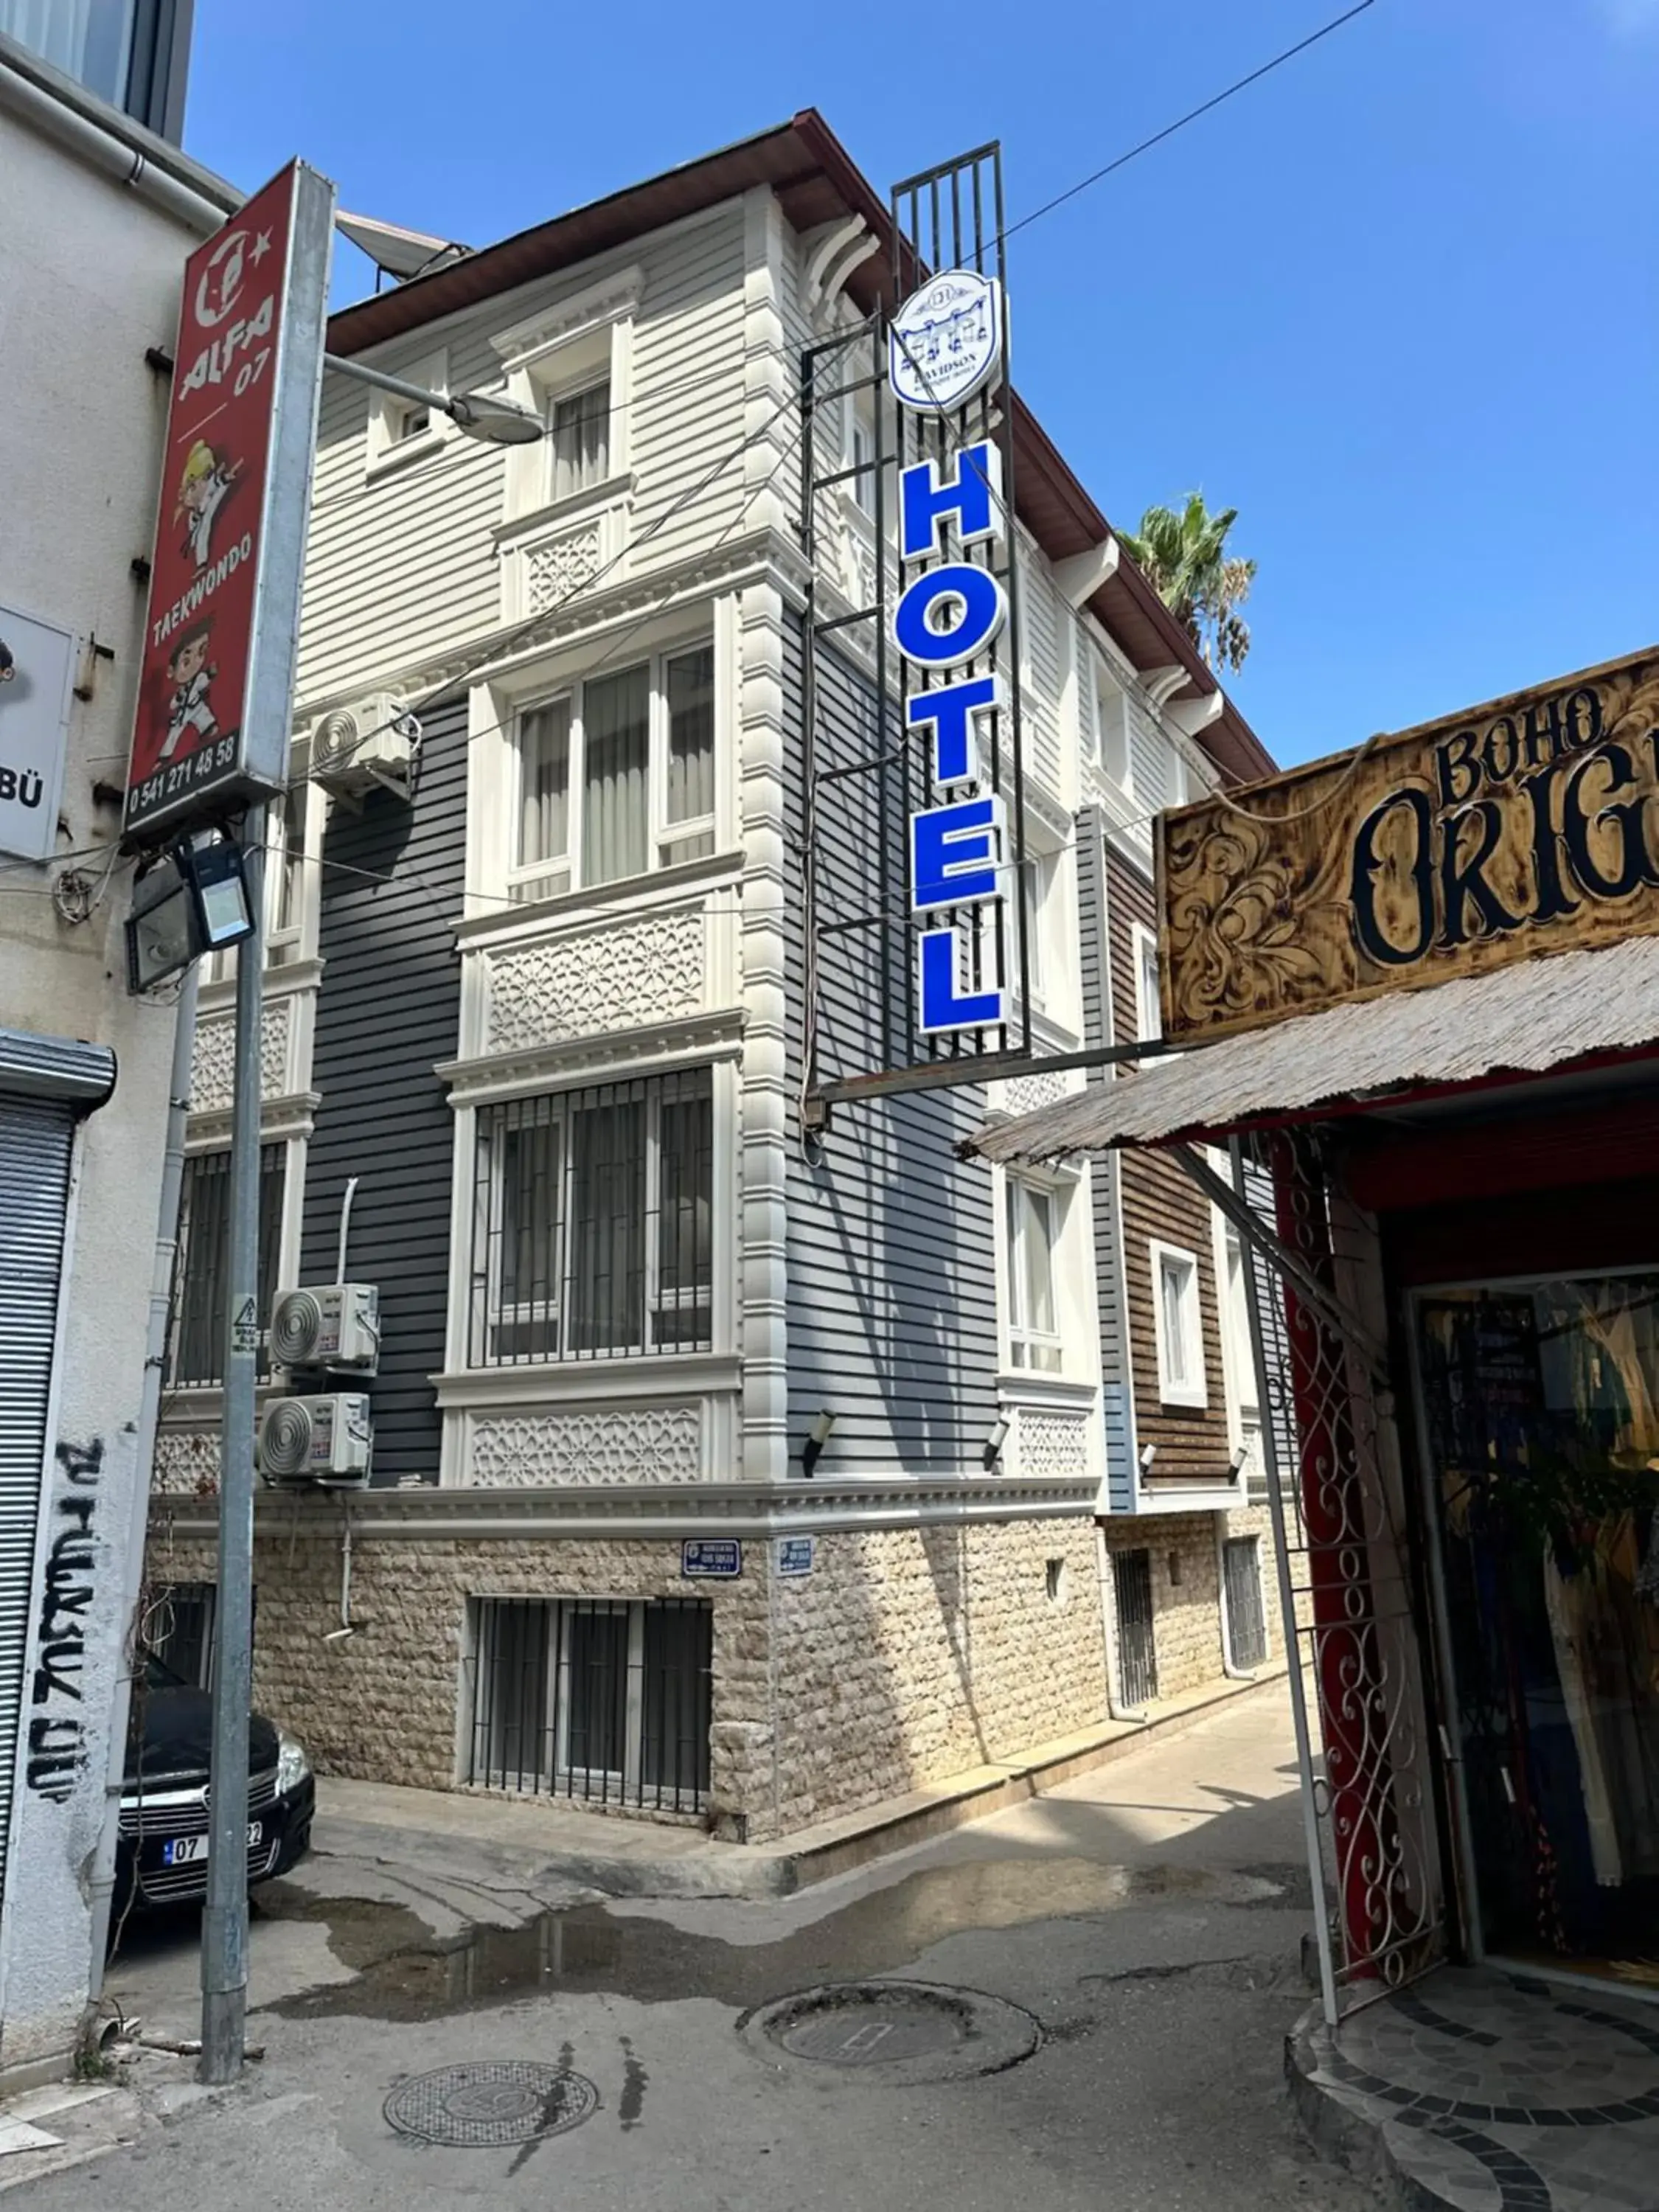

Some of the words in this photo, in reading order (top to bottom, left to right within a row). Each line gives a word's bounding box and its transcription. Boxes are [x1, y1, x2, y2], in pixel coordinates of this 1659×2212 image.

[179, 294, 274, 401] ALFA
[233, 347, 271, 397] 07
[153, 532, 253, 647] TAEKWONDO
[130, 788, 139, 813] 0
[141, 774, 164, 807] 541
[167, 759, 192, 793] 271
[195, 748, 213, 776] 48
[216, 736, 234, 766] 58
[894, 439, 1009, 1037] HOTEL
[1436, 686, 1604, 808] BOHO
[175, 1837, 198, 1860] 07
